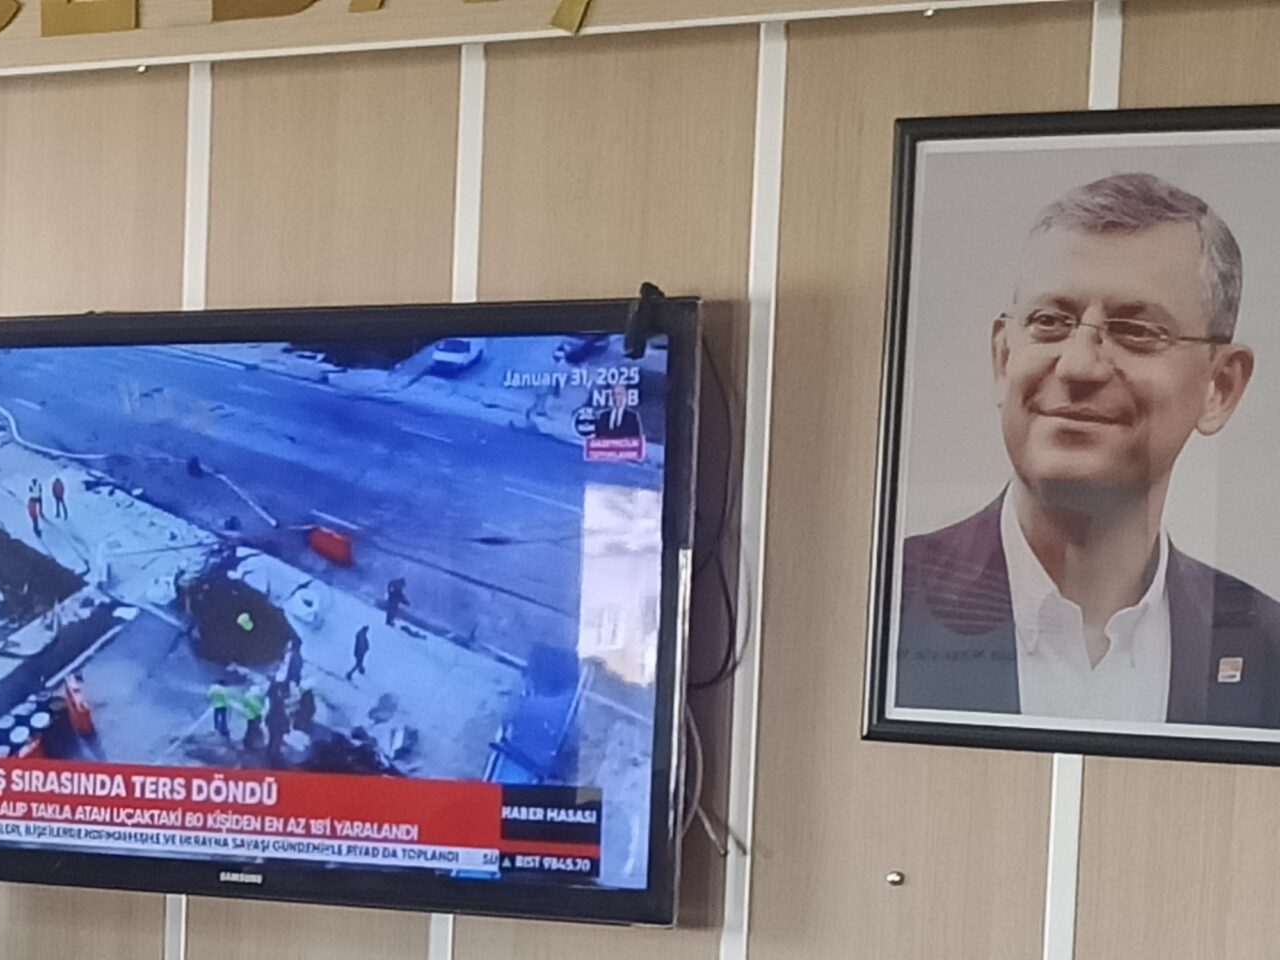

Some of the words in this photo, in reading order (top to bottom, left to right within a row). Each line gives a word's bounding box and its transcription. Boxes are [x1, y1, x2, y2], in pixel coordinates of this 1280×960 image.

[504, 370, 567, 388] January
[570, 369, 593, 388] 31,
[596, 367, 640, 385] 2025
[592, 389, 639, 407] NTB
[10, 769, 127, 797] SIRASINDA
[131, 775, 187, 800] TERS
[191, 773, 278, 806] DÖNDÜ
[30, 802, 72, 820] TAKLA
[74, 805, 110, 822] ATAN
[113, 806, 182, 828] UÇAKTAKİ
[207, 809, 262, 833] KİŞİDEN
[264, 816, 284, 833] EN
[286, 817, 307, 834] AZ
[333, 819, 419, 842] YARALANDI
